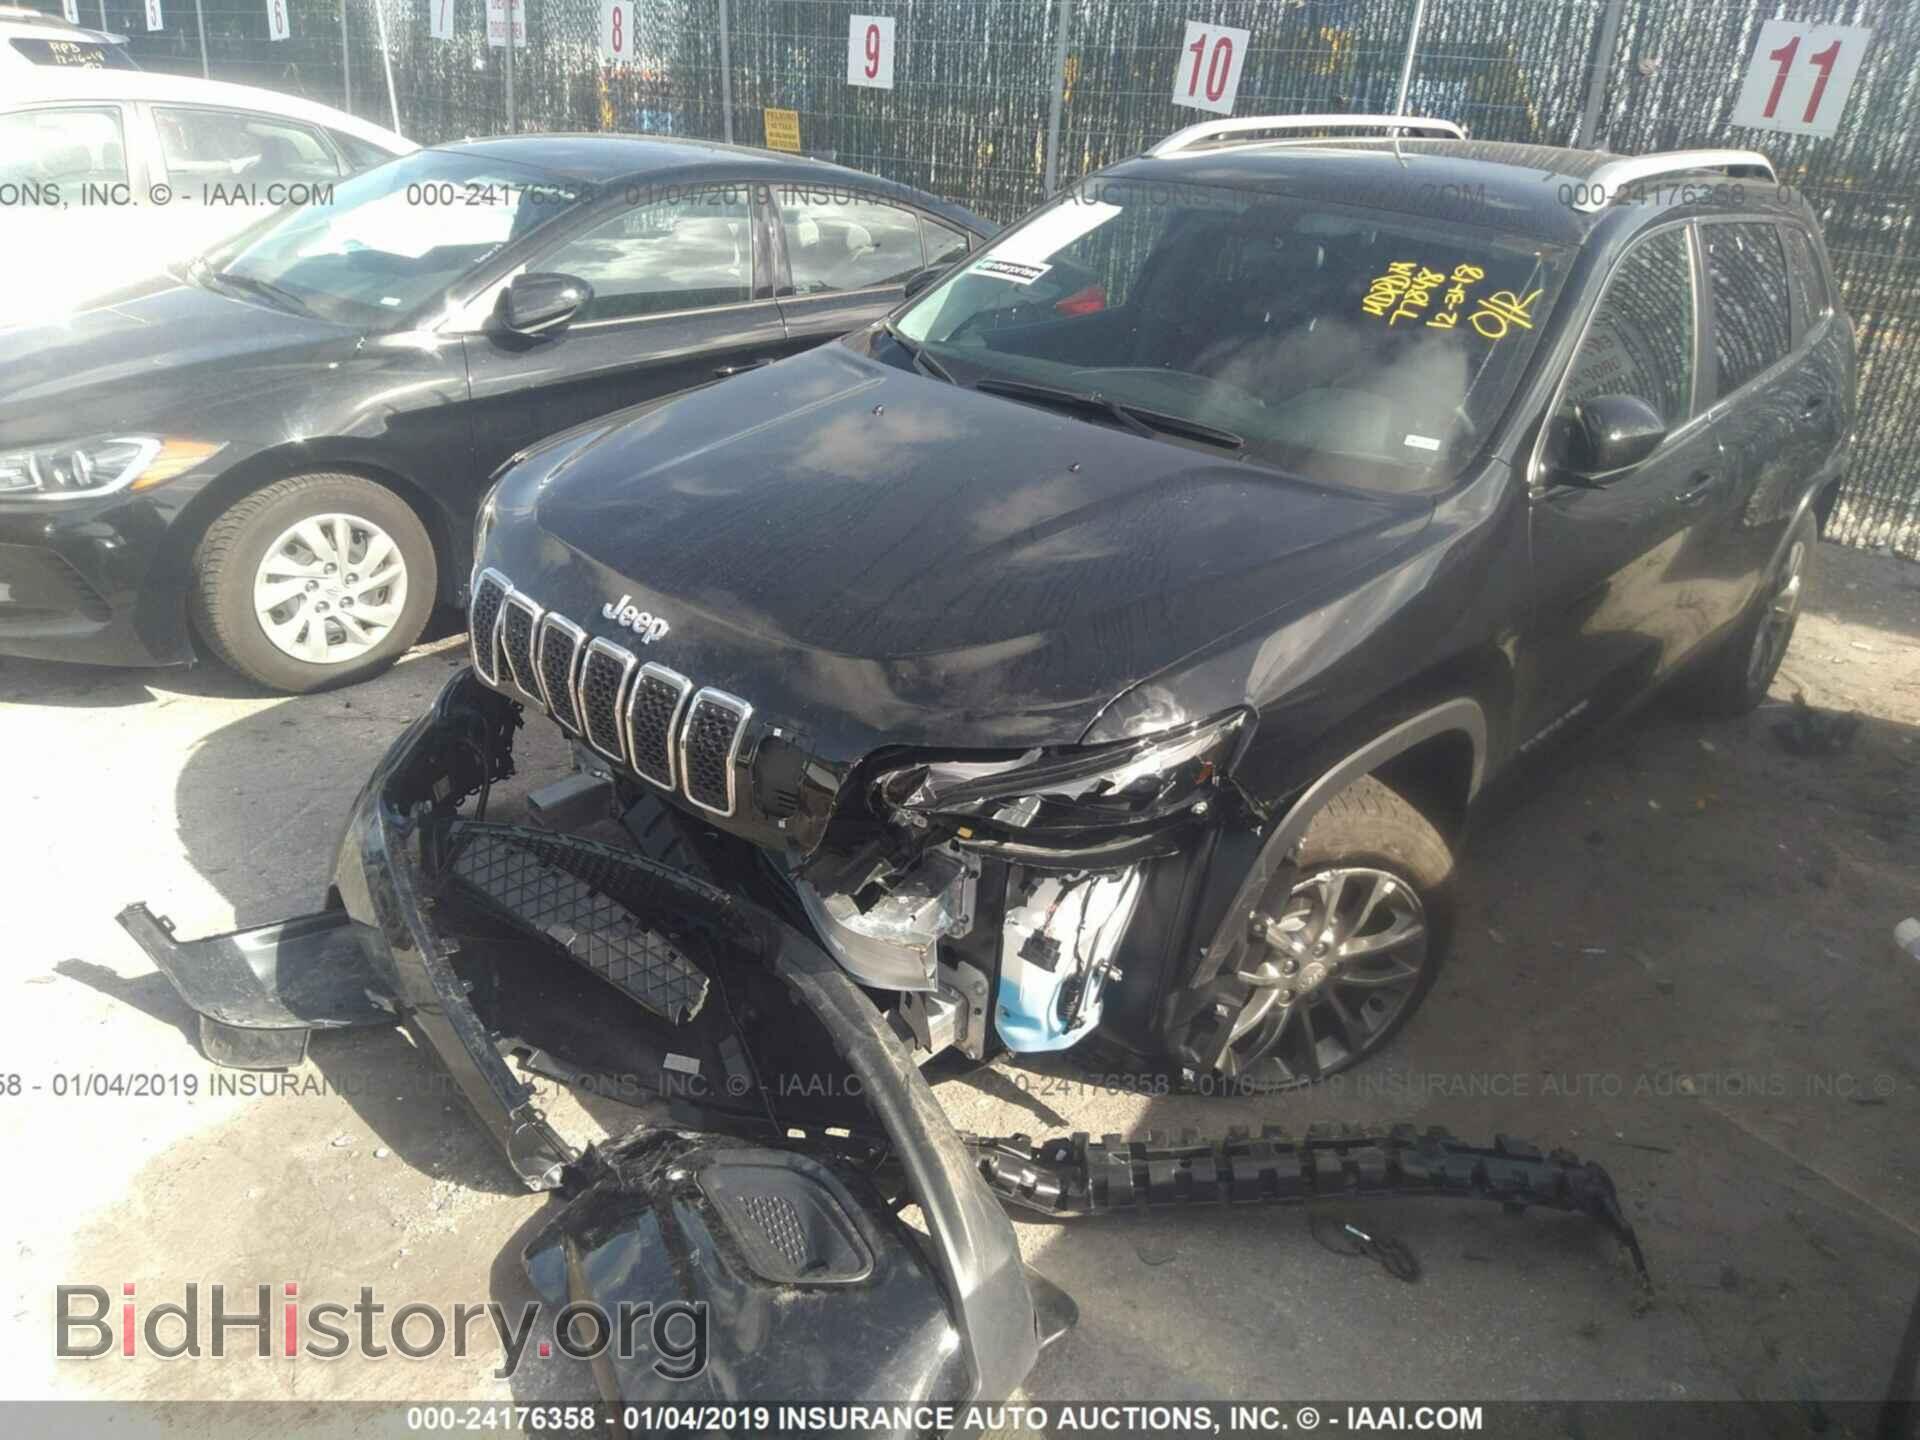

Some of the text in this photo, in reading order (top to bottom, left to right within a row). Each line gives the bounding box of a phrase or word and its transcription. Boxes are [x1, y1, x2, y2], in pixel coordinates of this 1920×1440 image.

[273, 0, 284, 34] 6
[612, 6, 623, 53] 8
[865, 23, 880, 79] 9
[1189, 33, 1233, 102] 10
[1763, 36, 1842, 123] 11
[602, 594, 670, 645] Jeep
